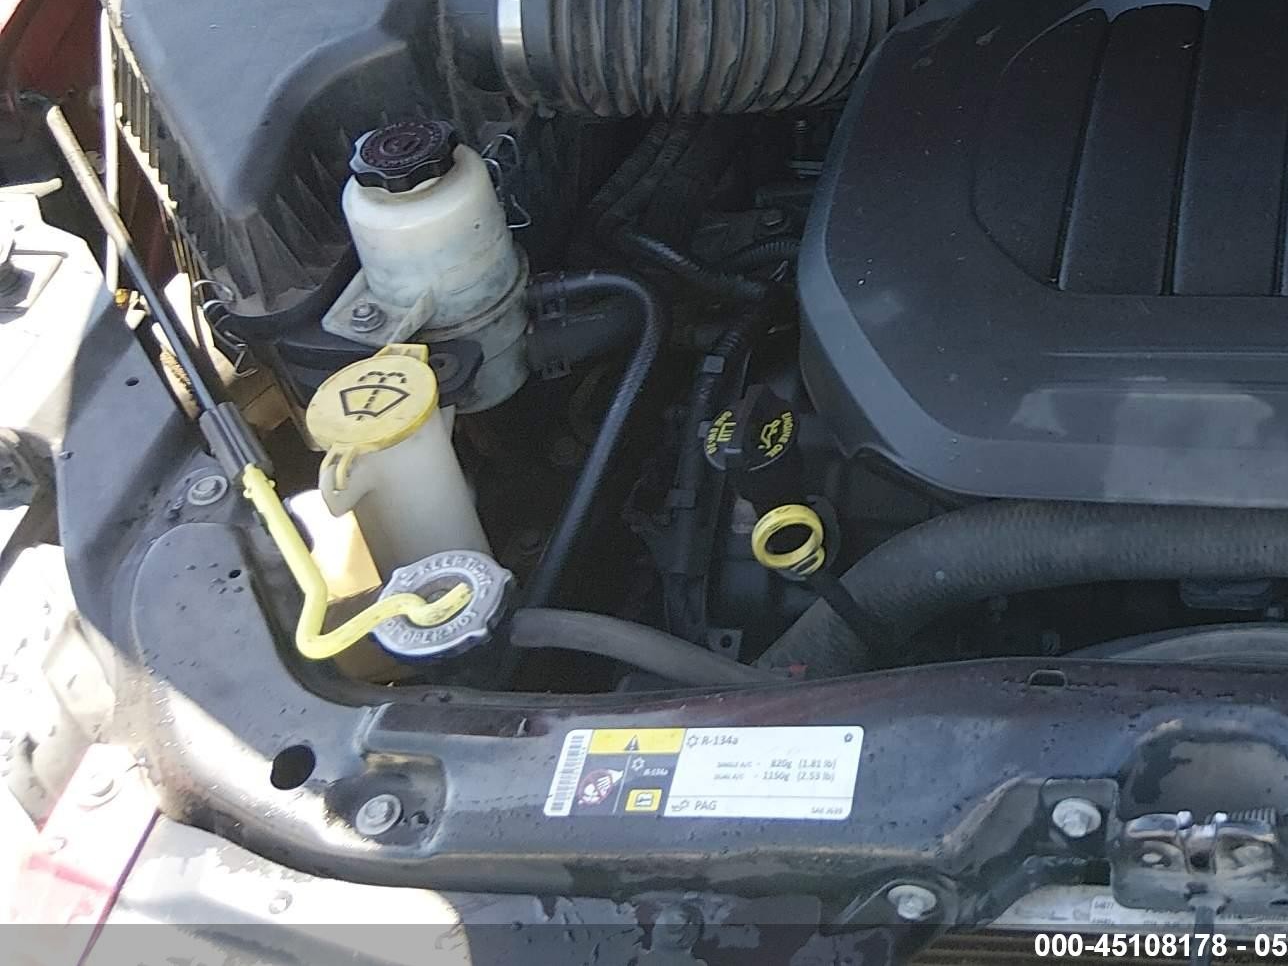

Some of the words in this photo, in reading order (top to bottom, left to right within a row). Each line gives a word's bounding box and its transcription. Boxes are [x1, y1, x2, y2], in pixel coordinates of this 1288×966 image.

[781, 411, 794, 443] ENGINE
[764, 443, 784, 458] OIL
[701, 735, 739, 746] R-134a
[694, 800, 718, 811] PAG
